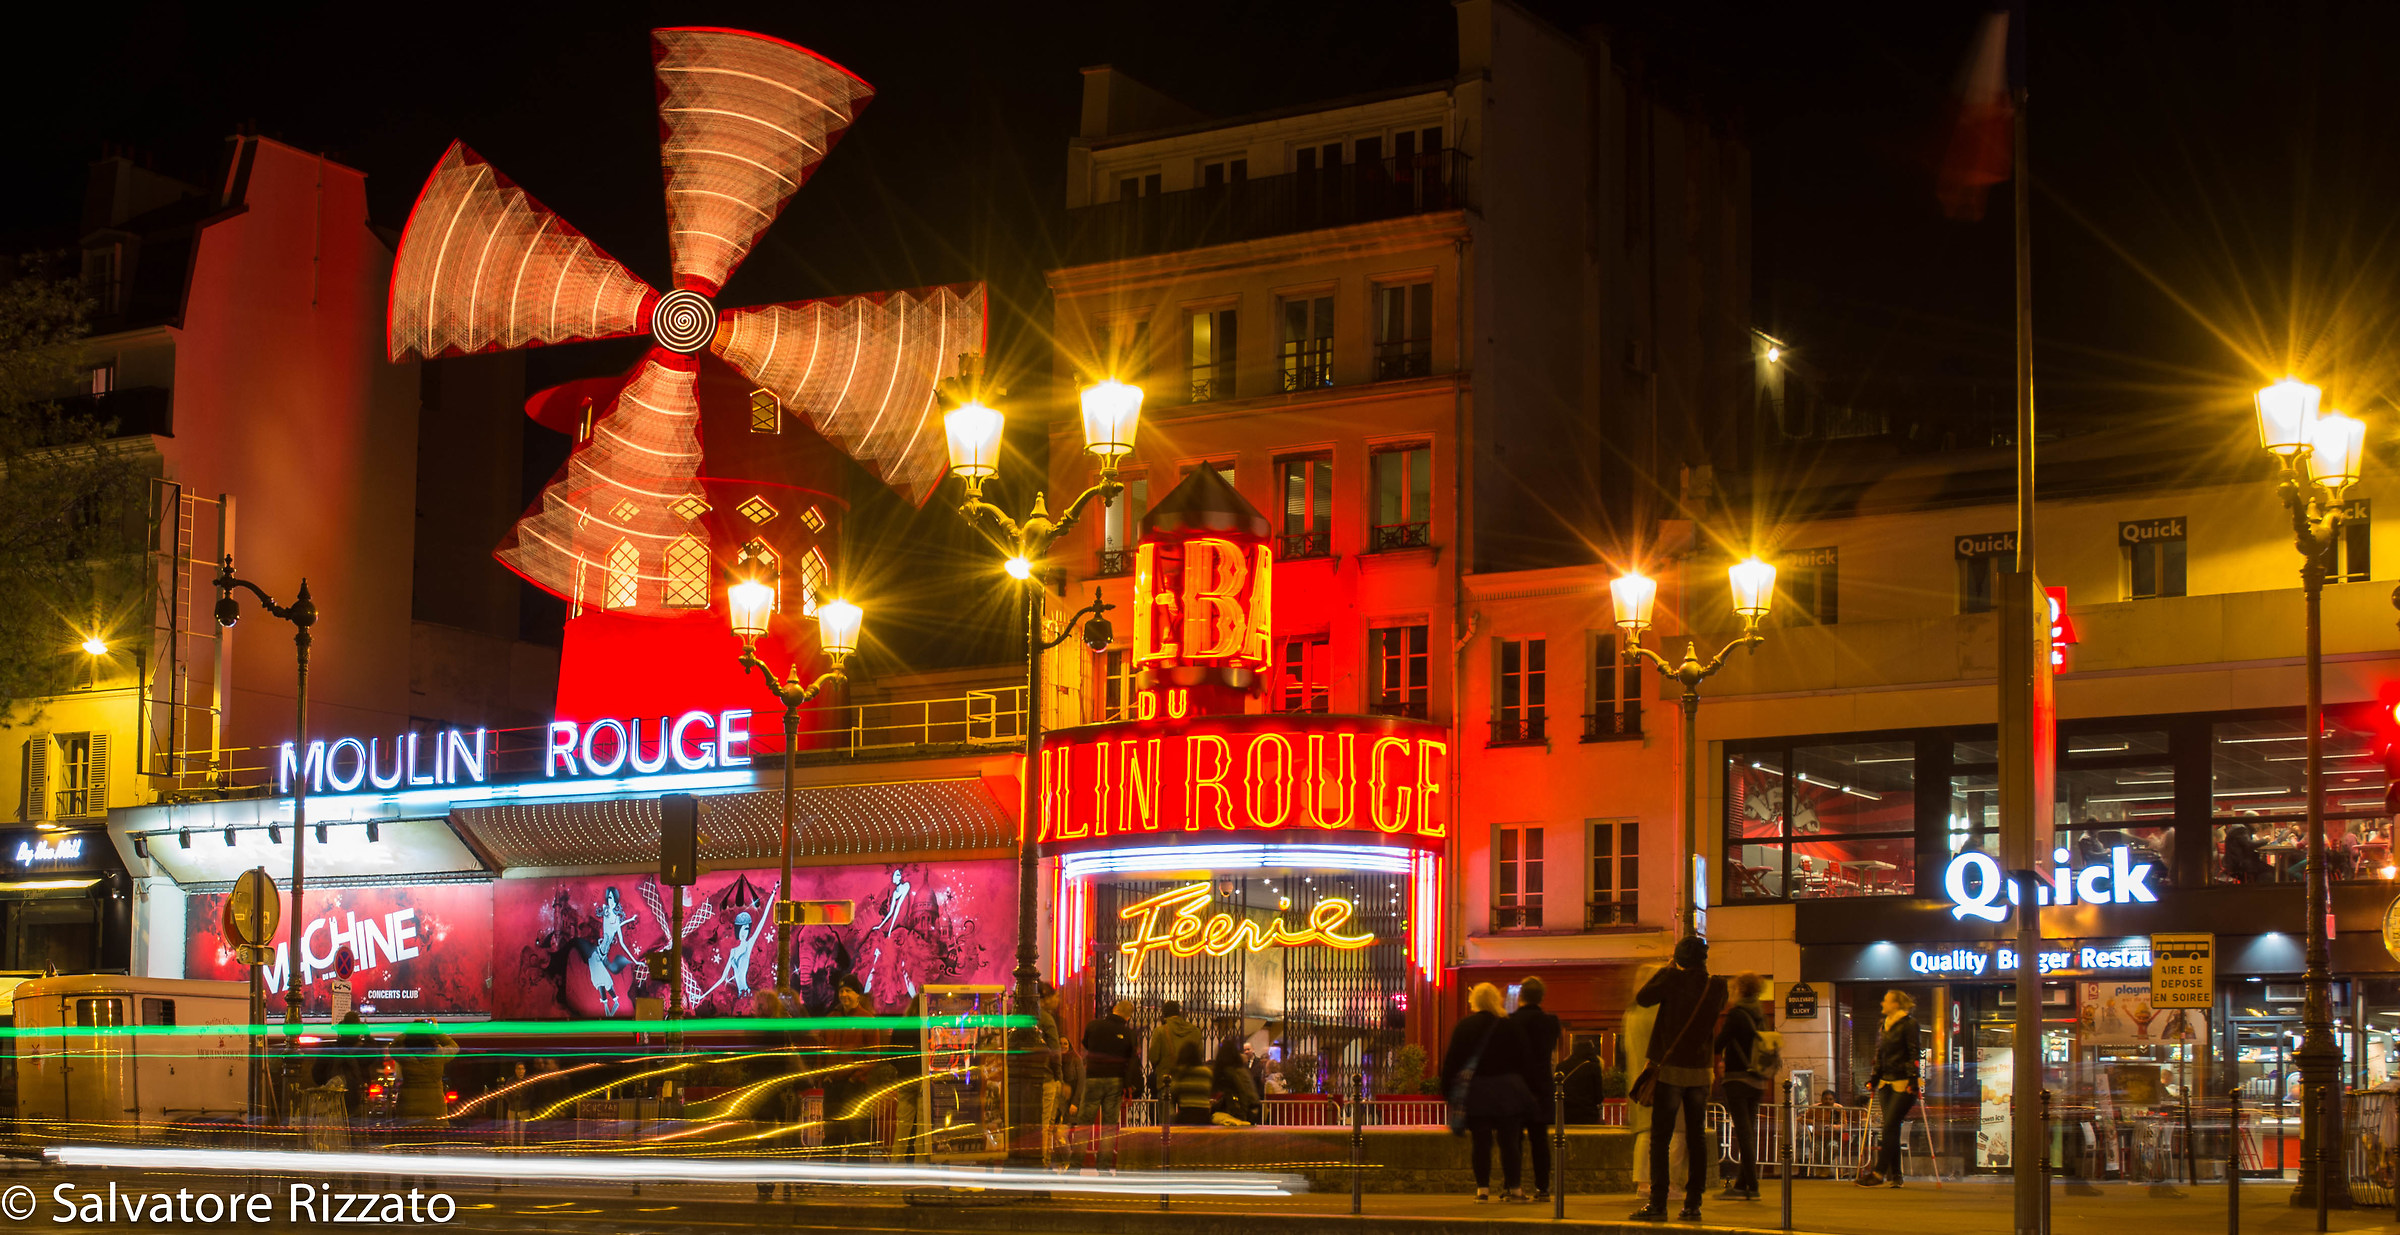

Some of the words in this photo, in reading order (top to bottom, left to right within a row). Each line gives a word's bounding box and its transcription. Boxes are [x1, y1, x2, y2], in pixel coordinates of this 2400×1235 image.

[2122, 521, 2183, 544] Quick
[1958, 535, 2015, 556] Quick
[1138, 689, 1188, 720] DU
[280, 728, 486, 793] MOULIN
[545, 709, 752, 778] ROUGE
[1185, 733, 1447, 838] ROUGE
[1120, 881, 1375, 981] Féerie
[1910, 949, 1988, 975] Quality
[2161, 965, 2184, 975] AIRE
[2190, 965, 2203, 974] DE
[367, 989, 401, 1000] CONCERTS
[401, 988, 419, 999] CLUB
[2161, 979, 2203, 988] DEPOSE
[2154, 993, 2167, 1002] EN
[2172, 993, 2210, 1001] SOIREE
